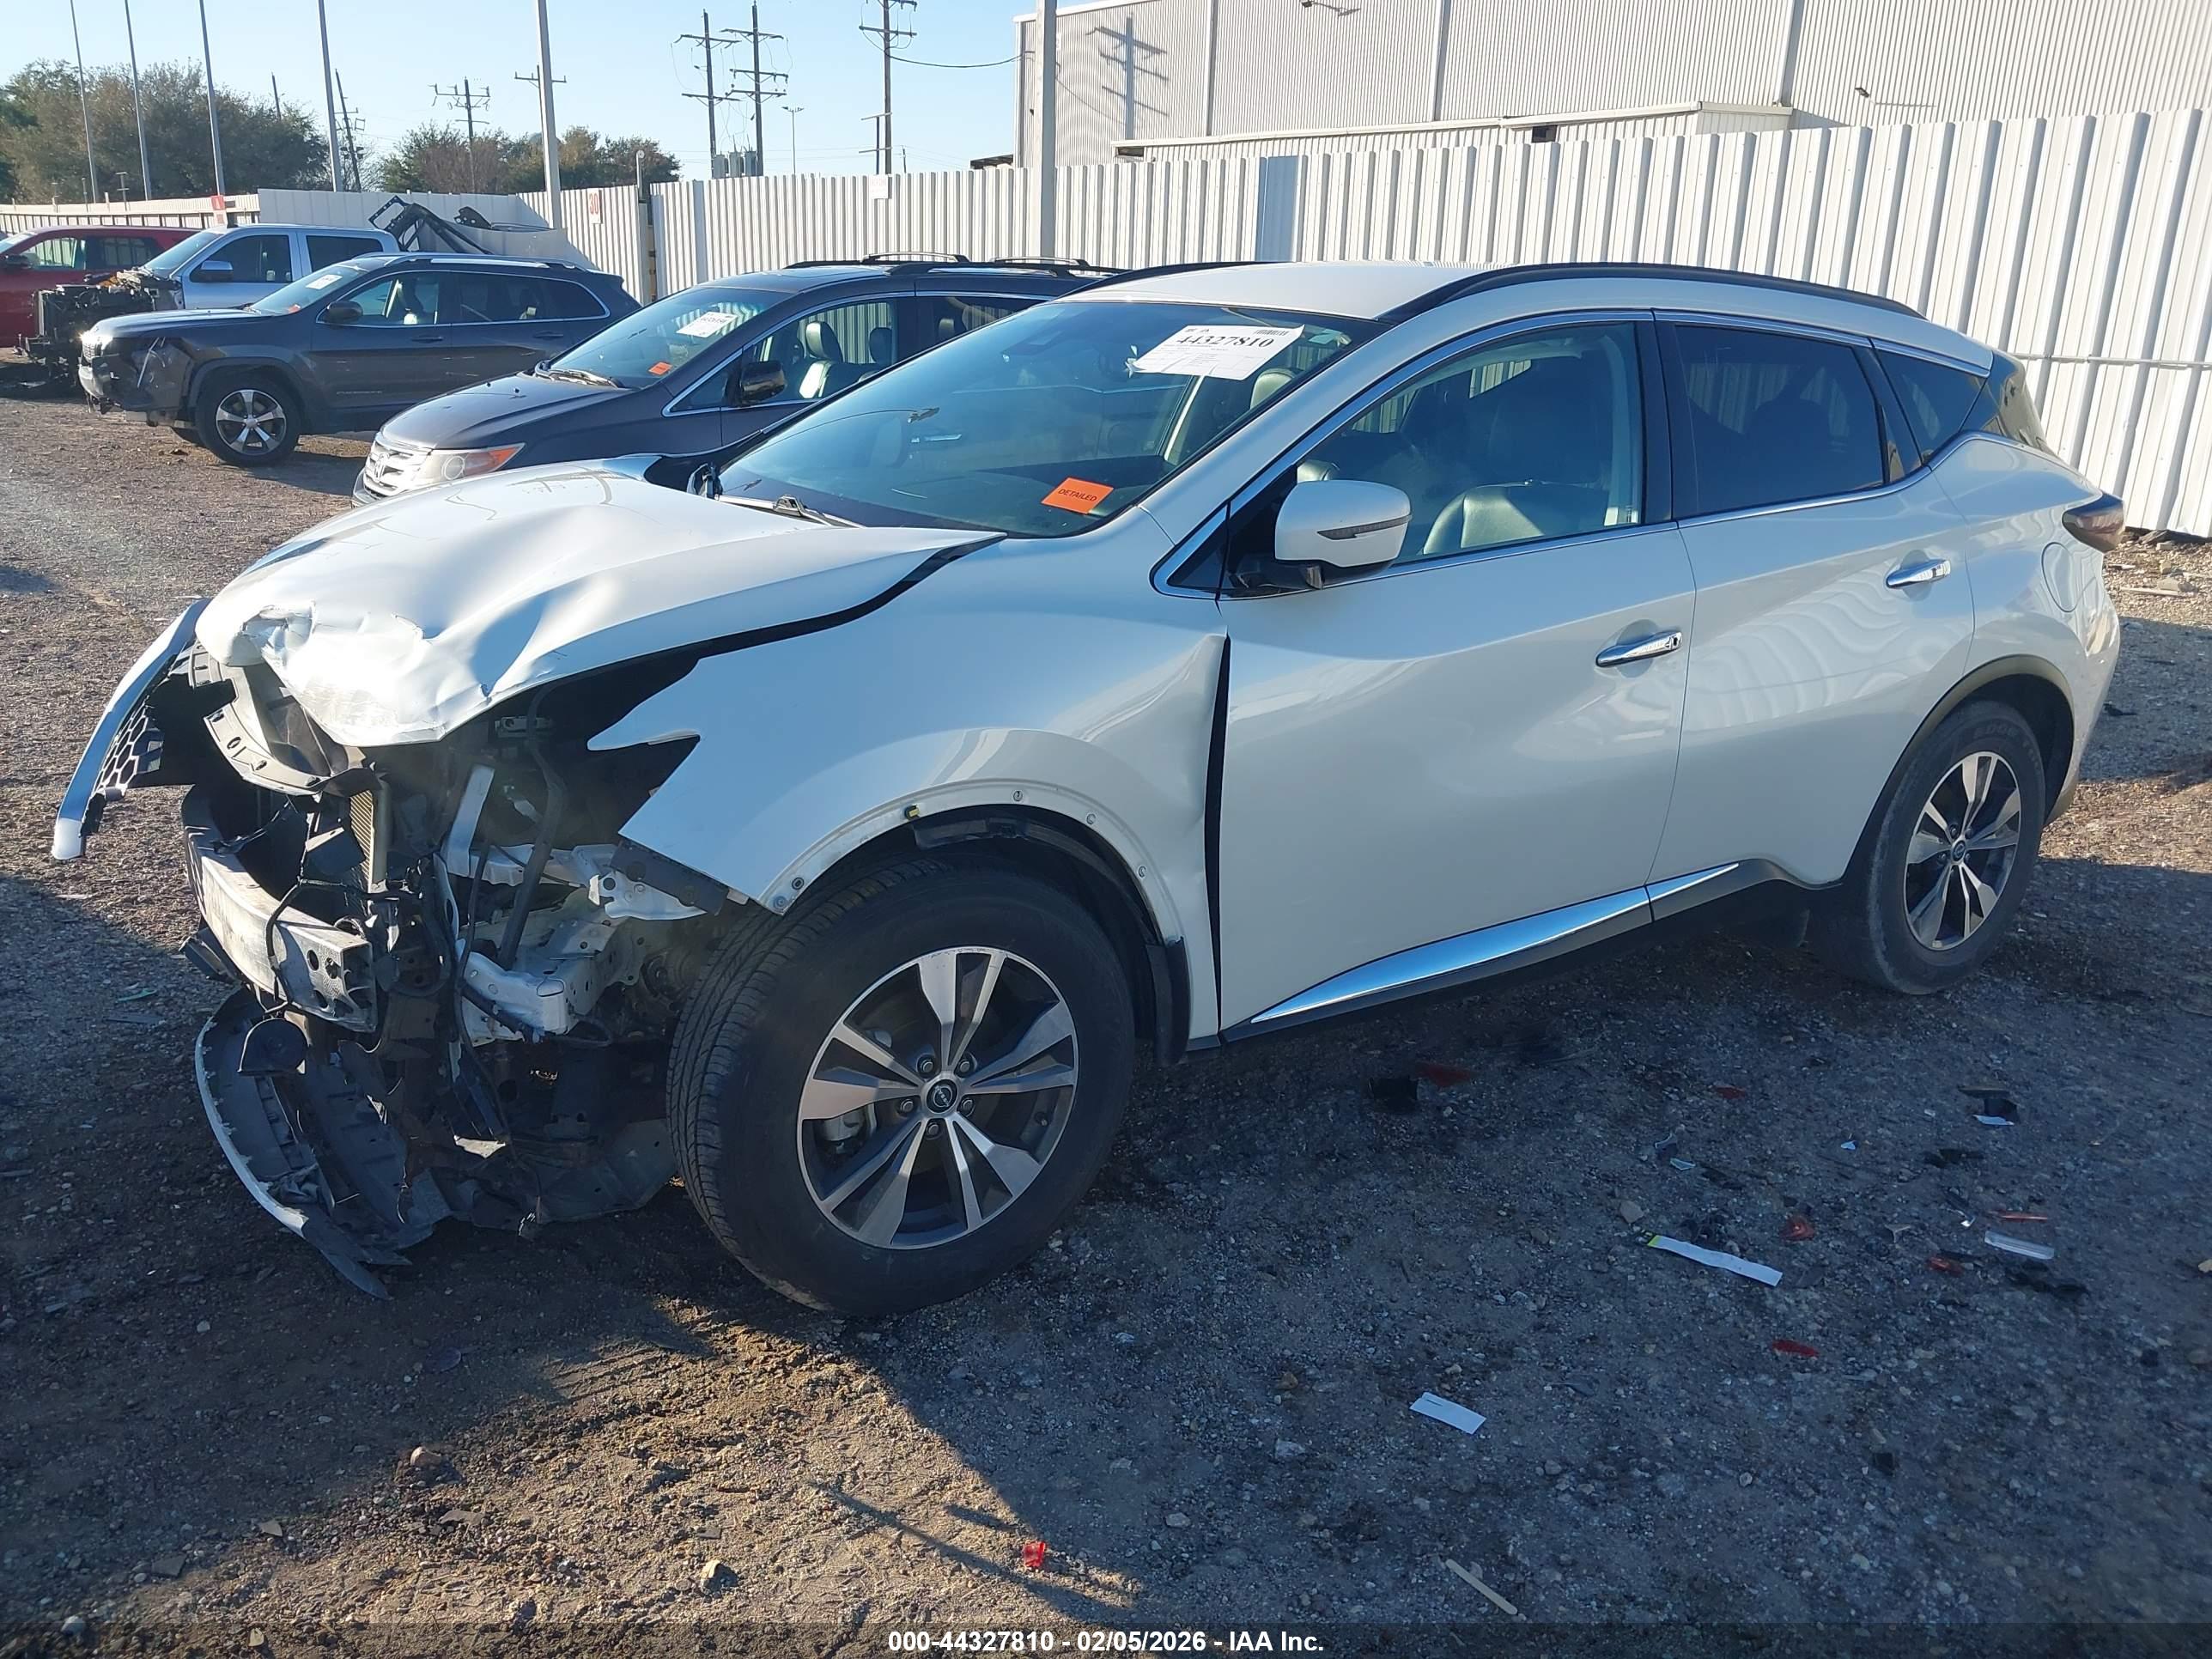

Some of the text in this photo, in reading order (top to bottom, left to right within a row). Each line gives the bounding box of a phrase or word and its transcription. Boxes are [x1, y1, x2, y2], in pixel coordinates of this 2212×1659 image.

[589, 193, 599, 215] 30
[1176, 335, 1274, 348] 44327810
[1058, 489, 1097, 501] DETAILED
